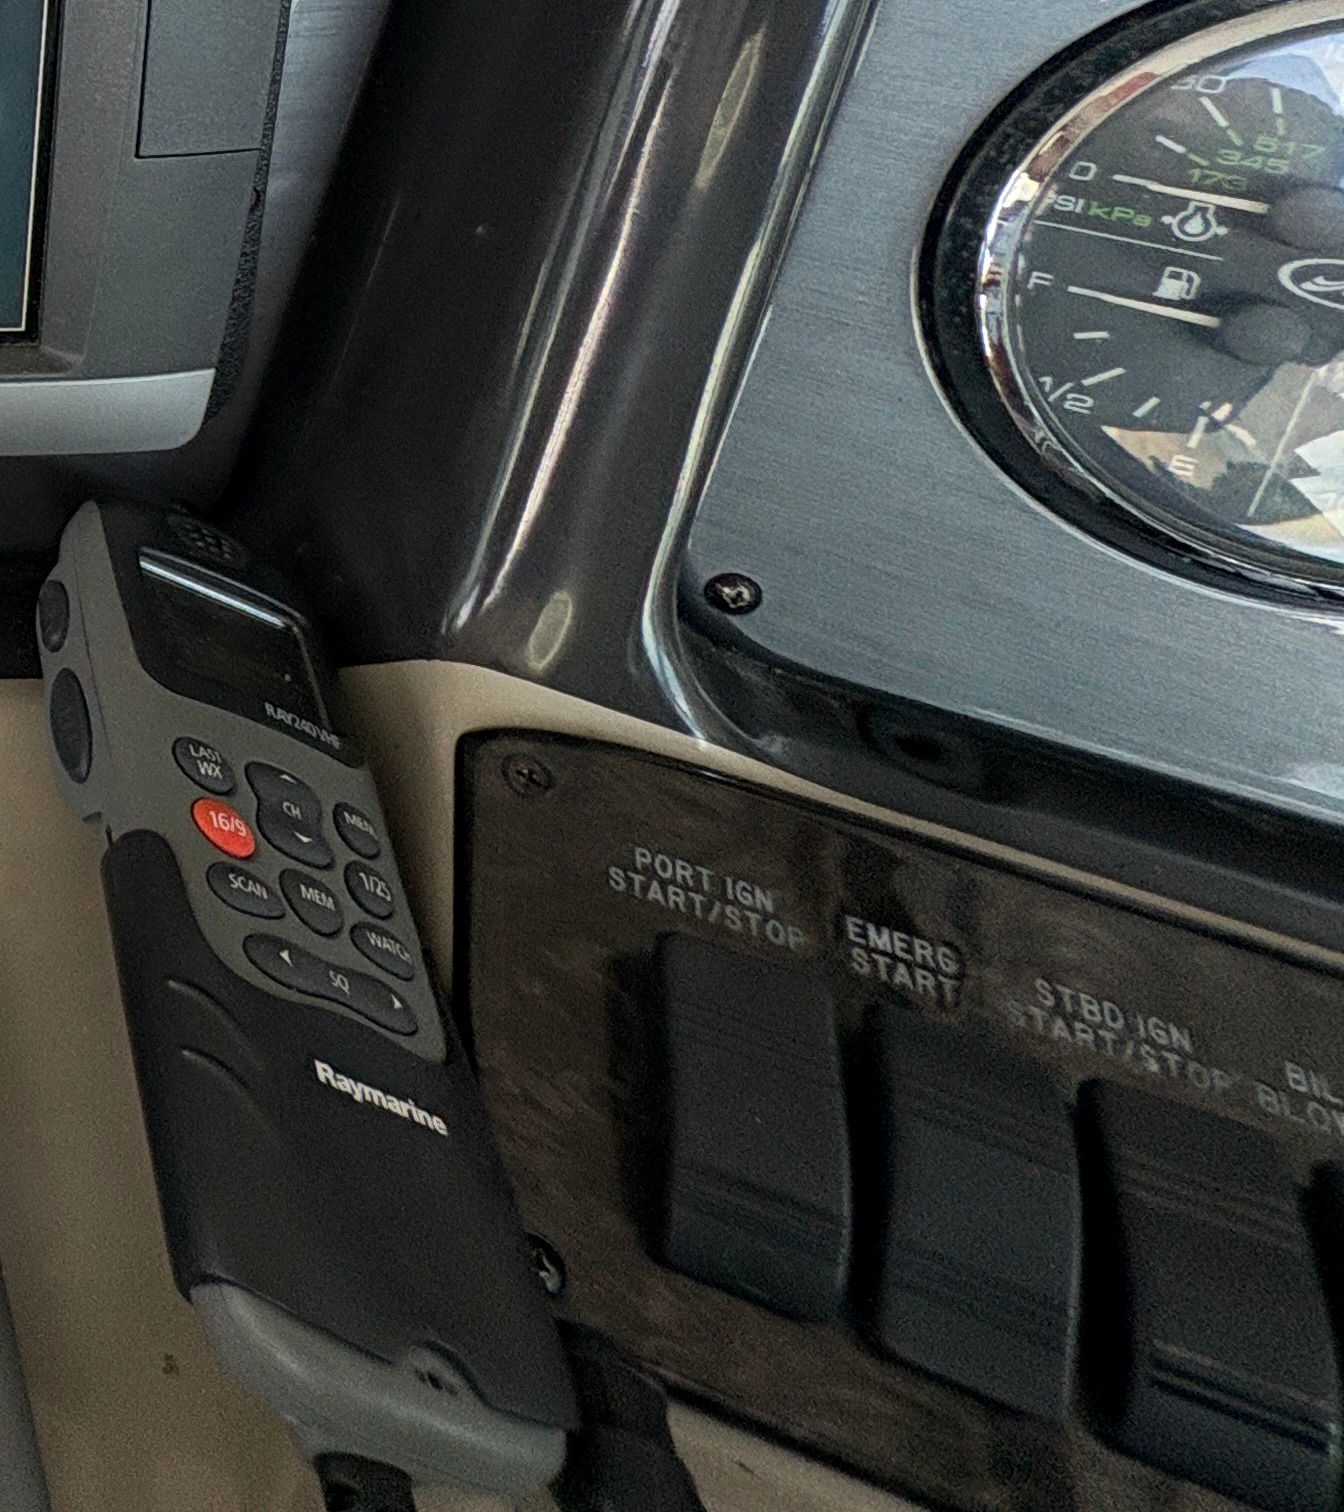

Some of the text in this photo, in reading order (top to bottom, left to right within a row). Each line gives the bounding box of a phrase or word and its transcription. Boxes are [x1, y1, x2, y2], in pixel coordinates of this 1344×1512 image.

[1087, 201, 1154, 229] kPa
[1026, 270, 1055, 290] F
[196, 759, 224, 780] WX
[209, 809, 248, 838] 16/9
[282, 800, 303, 821] CH
[227, 873, 269, 901] SCAN
[633, 846, 775, 914] PORT IGN
[299, 883, 336, 912] MEM
[608, 865, 808, 952] START/STOP
[845, 915, 961, 975] EMERG
[328, 970, 350, 996] SQ
[851, 947, 961, 1004] START
[1033, 976, 1194, 1054] STBD IGN
[313, 1058, 449, 1138] Raymarine
